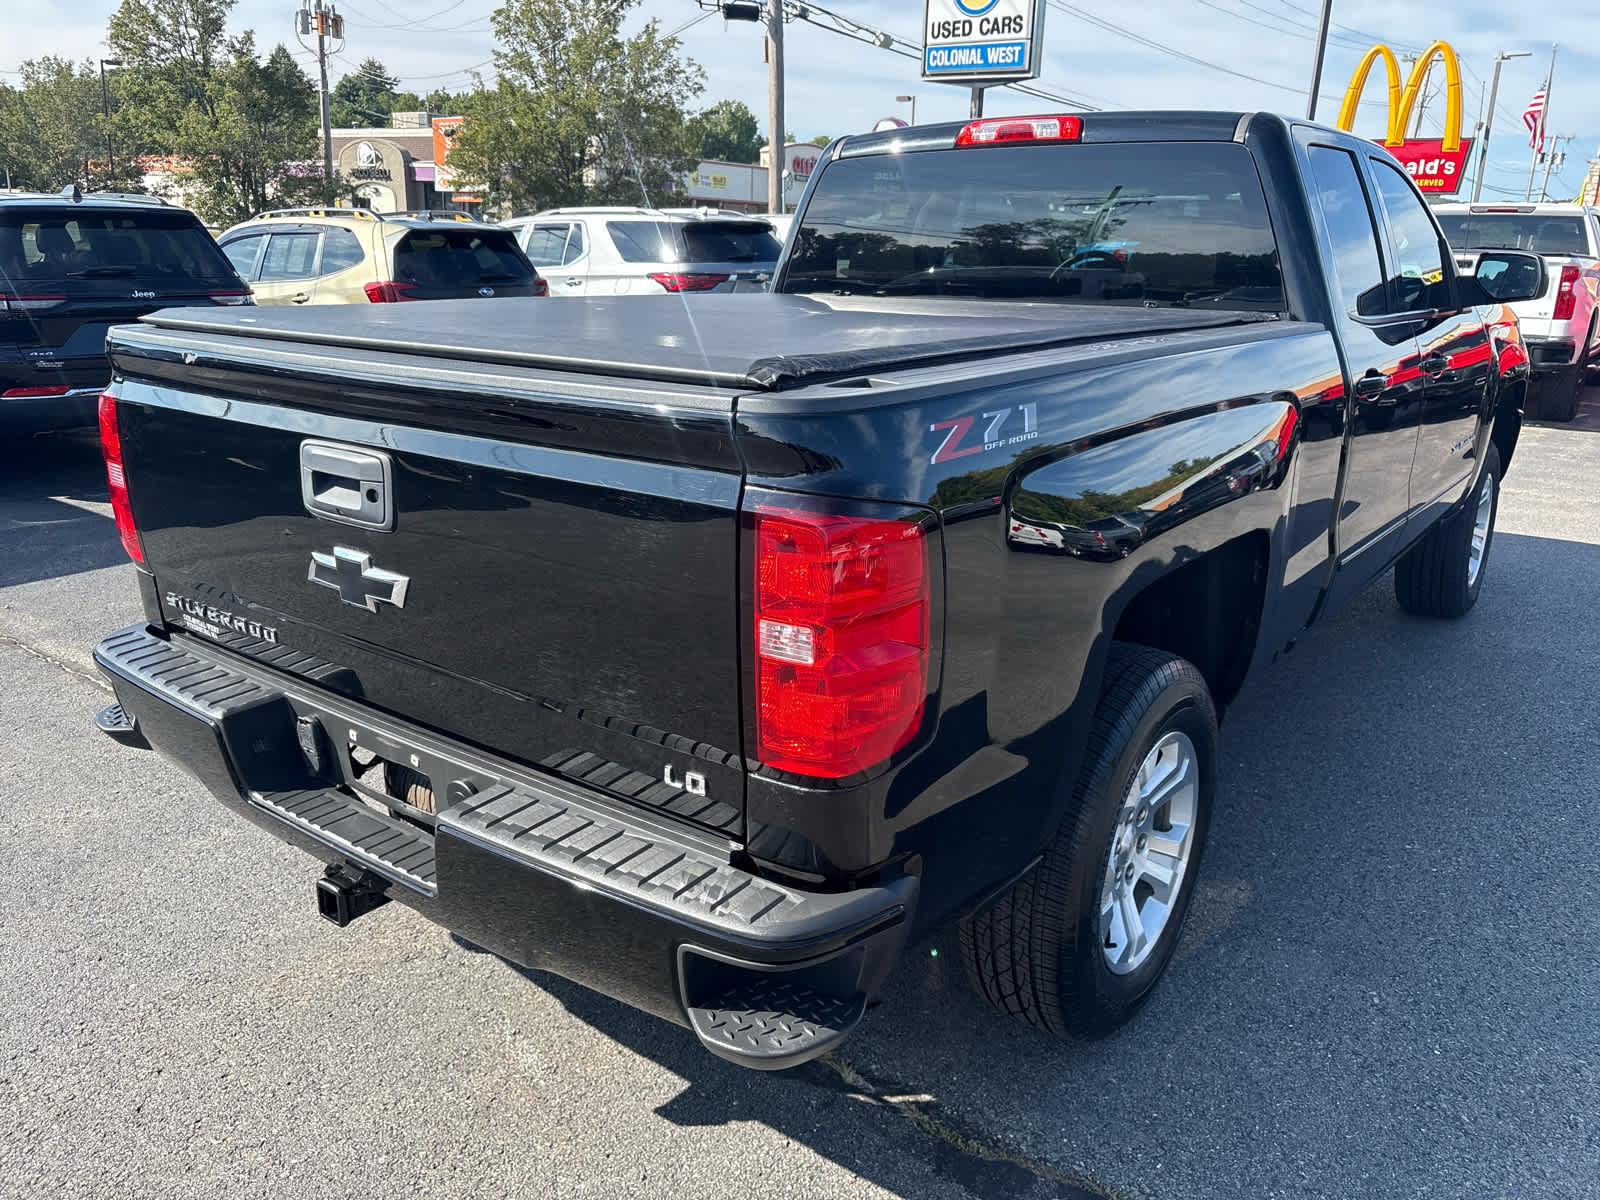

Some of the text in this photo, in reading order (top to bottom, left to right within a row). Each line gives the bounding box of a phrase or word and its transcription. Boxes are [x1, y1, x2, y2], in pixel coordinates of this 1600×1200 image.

[931, 14, 1024, 39] USED CARS
[929, 46, 1022, 67] COLONIAL WEST
[1403, 158, 1456, 175] ald's
[131, 289, 156, 299] Jeep
[930, 401, 1039, 465] Z71
[984, 431, 1039, 451] OFF ROAD
[166, 591, 278, 643] SILVERADO
